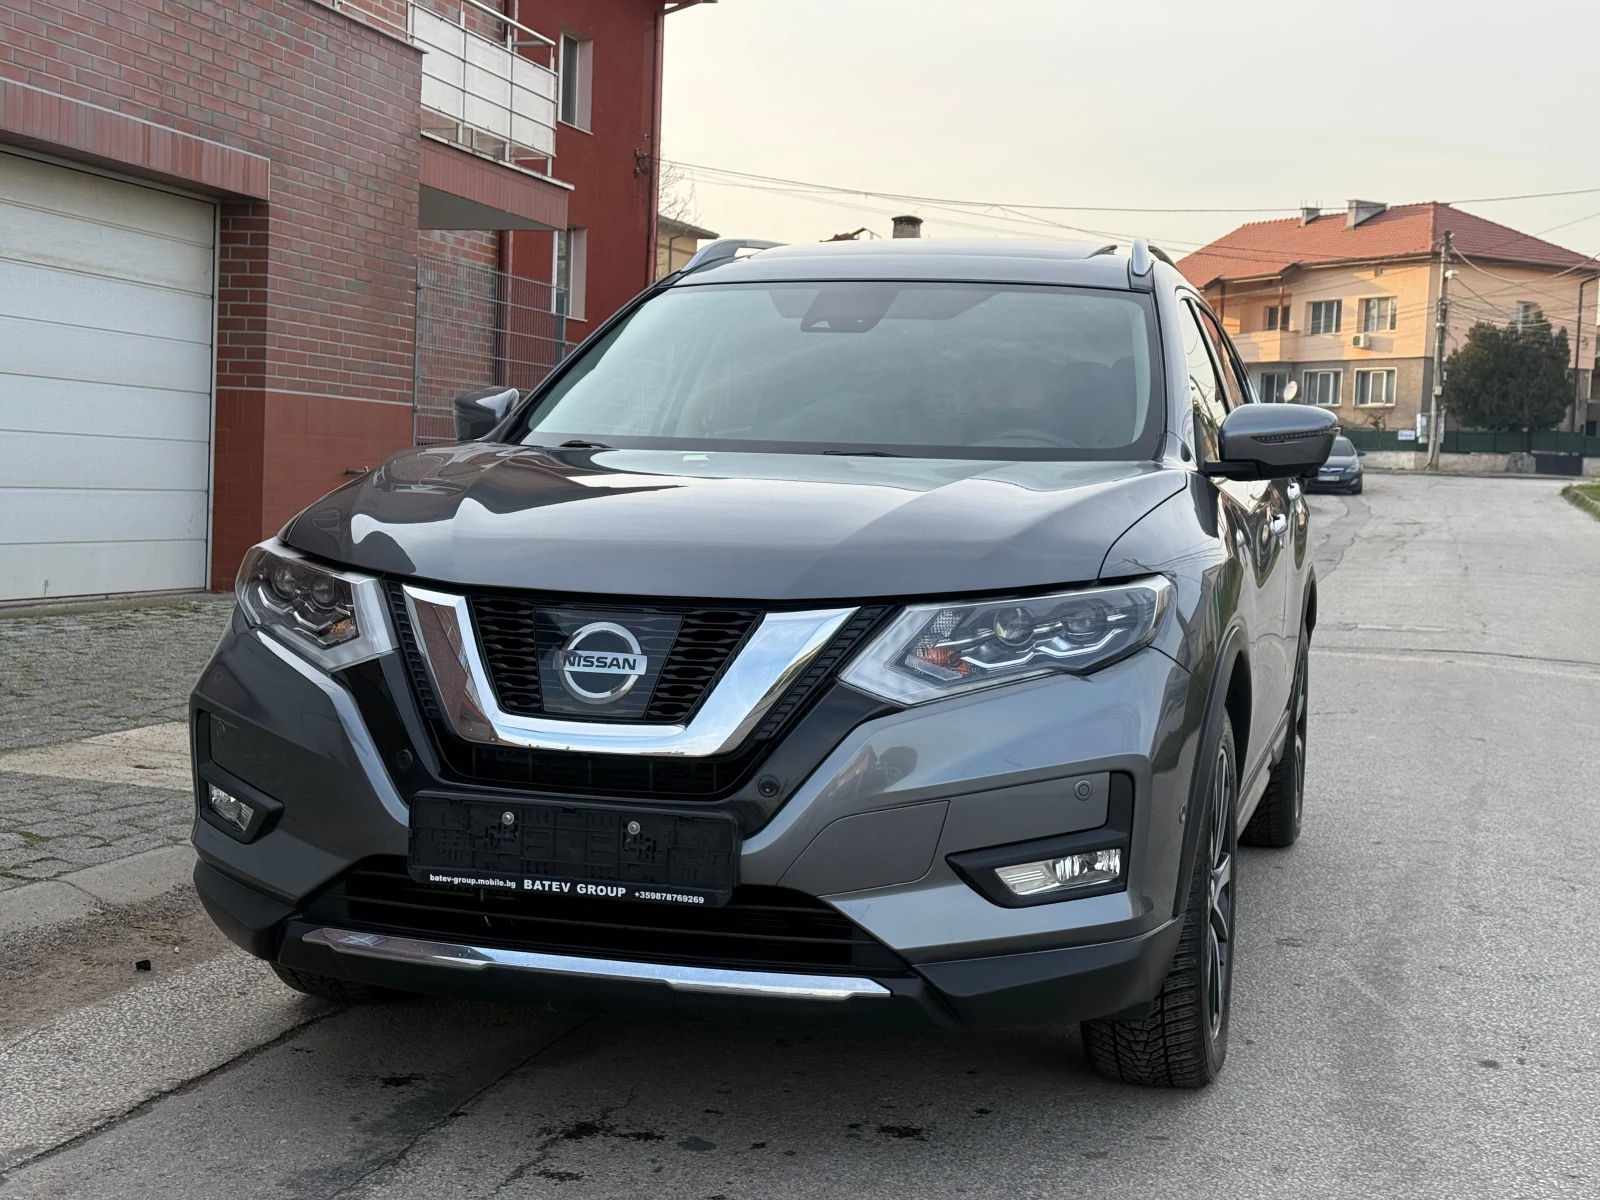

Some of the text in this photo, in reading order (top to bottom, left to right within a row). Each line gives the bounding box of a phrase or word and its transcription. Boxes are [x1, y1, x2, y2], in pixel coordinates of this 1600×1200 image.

[563, 654, 637, 671] NISSAN
[429, 873, 705, 904] batev-group.mobile.bg BATEV GROUP +359878769269
